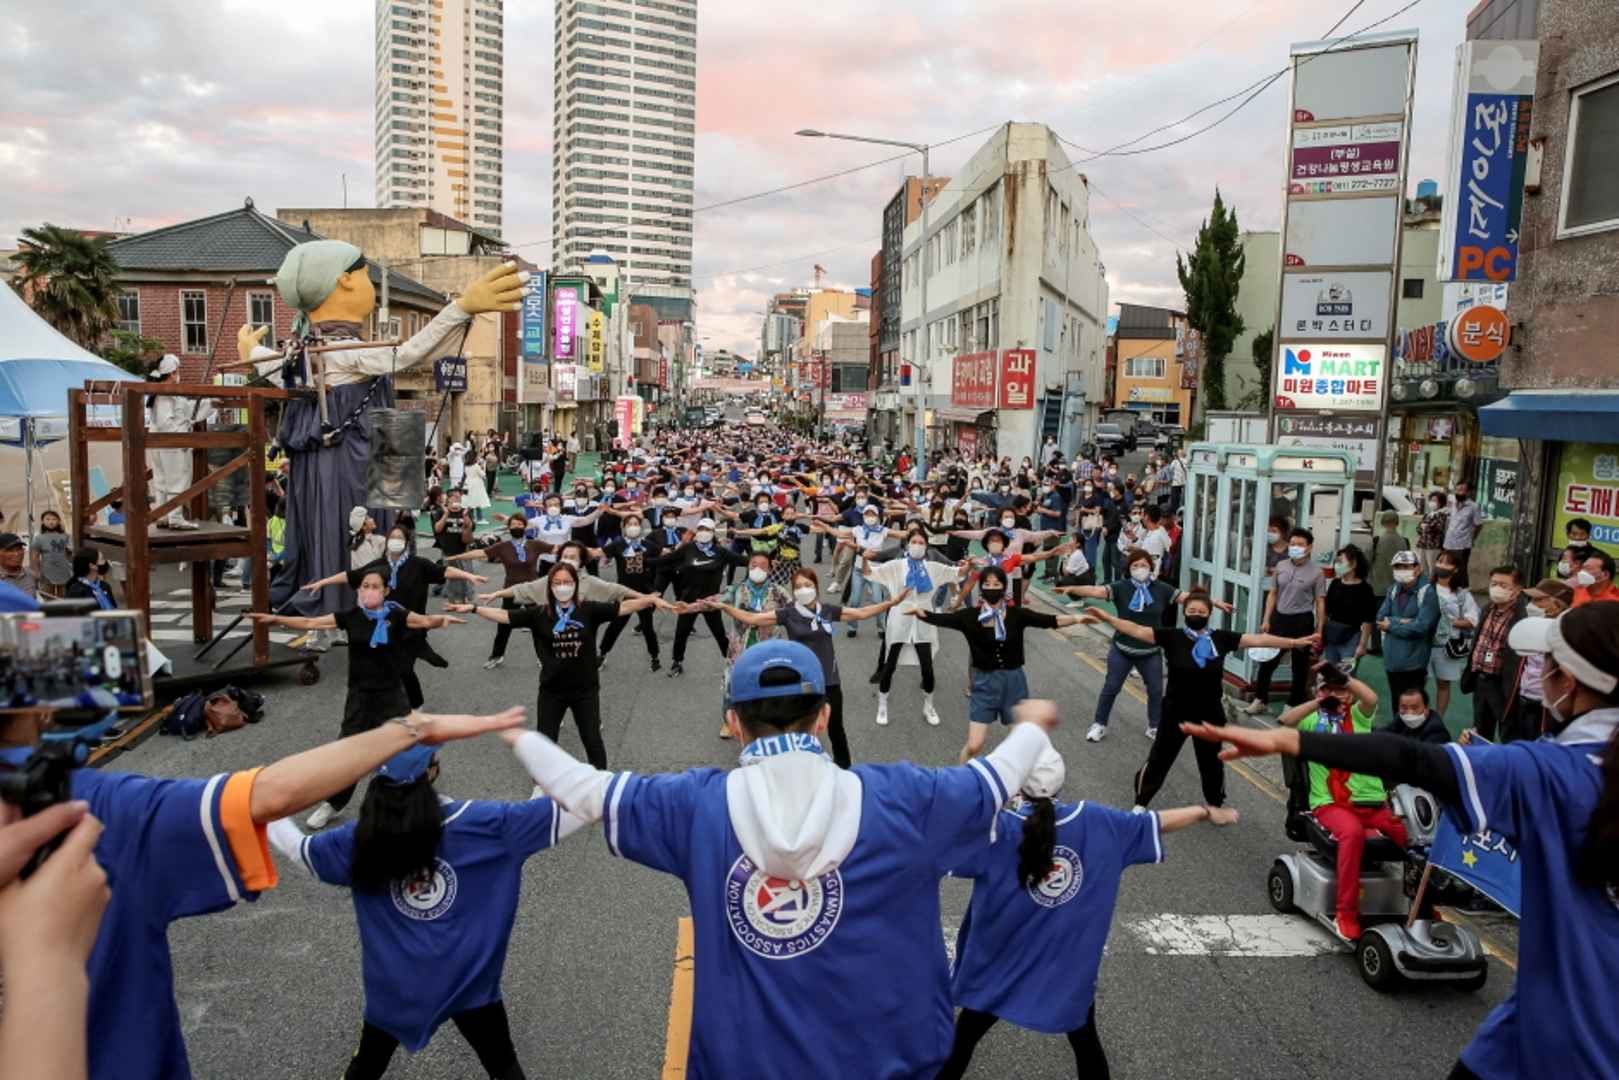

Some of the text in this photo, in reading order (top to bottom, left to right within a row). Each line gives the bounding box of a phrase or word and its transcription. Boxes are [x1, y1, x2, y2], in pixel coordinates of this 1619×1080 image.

[1457, 246, 1511, 281] PC
[1461, 321, 1505, 346] 분식
[1008, 353, 1031, 404] 과일
[1320, 360, 1380, 376] MART
[1284, 379, 1377, 395] 미원종합마트
[728, 879, 782, 954] ASSOCIATION
[787, 878, 838, 953] GYMNASTICS
